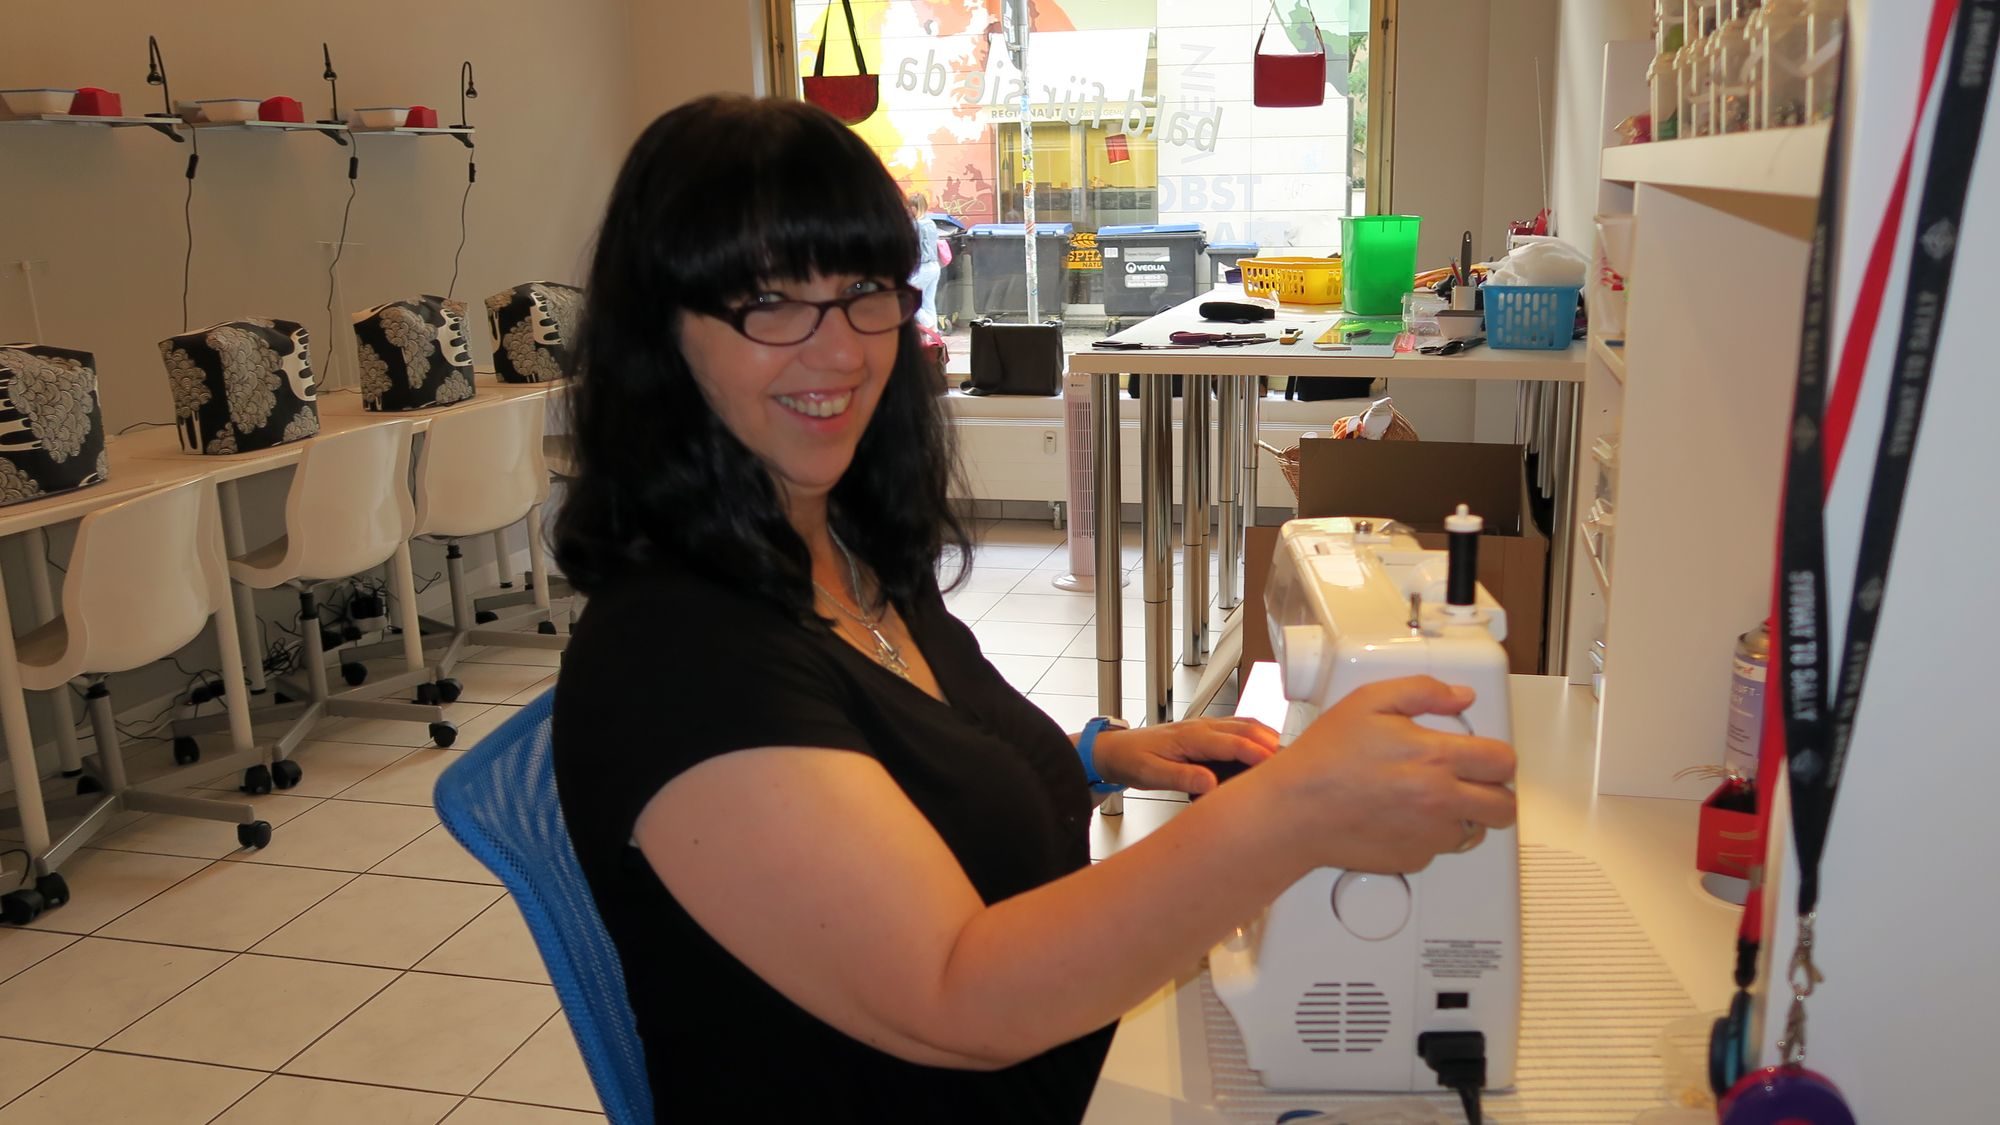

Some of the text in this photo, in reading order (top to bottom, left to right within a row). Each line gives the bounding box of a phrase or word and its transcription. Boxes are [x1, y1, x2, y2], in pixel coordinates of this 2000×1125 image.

[1136, 264, 1166, 272] VEOLIA
[1789, 640, 1818, 665] TO
[1789, 668, 1818, 721] SALLY
